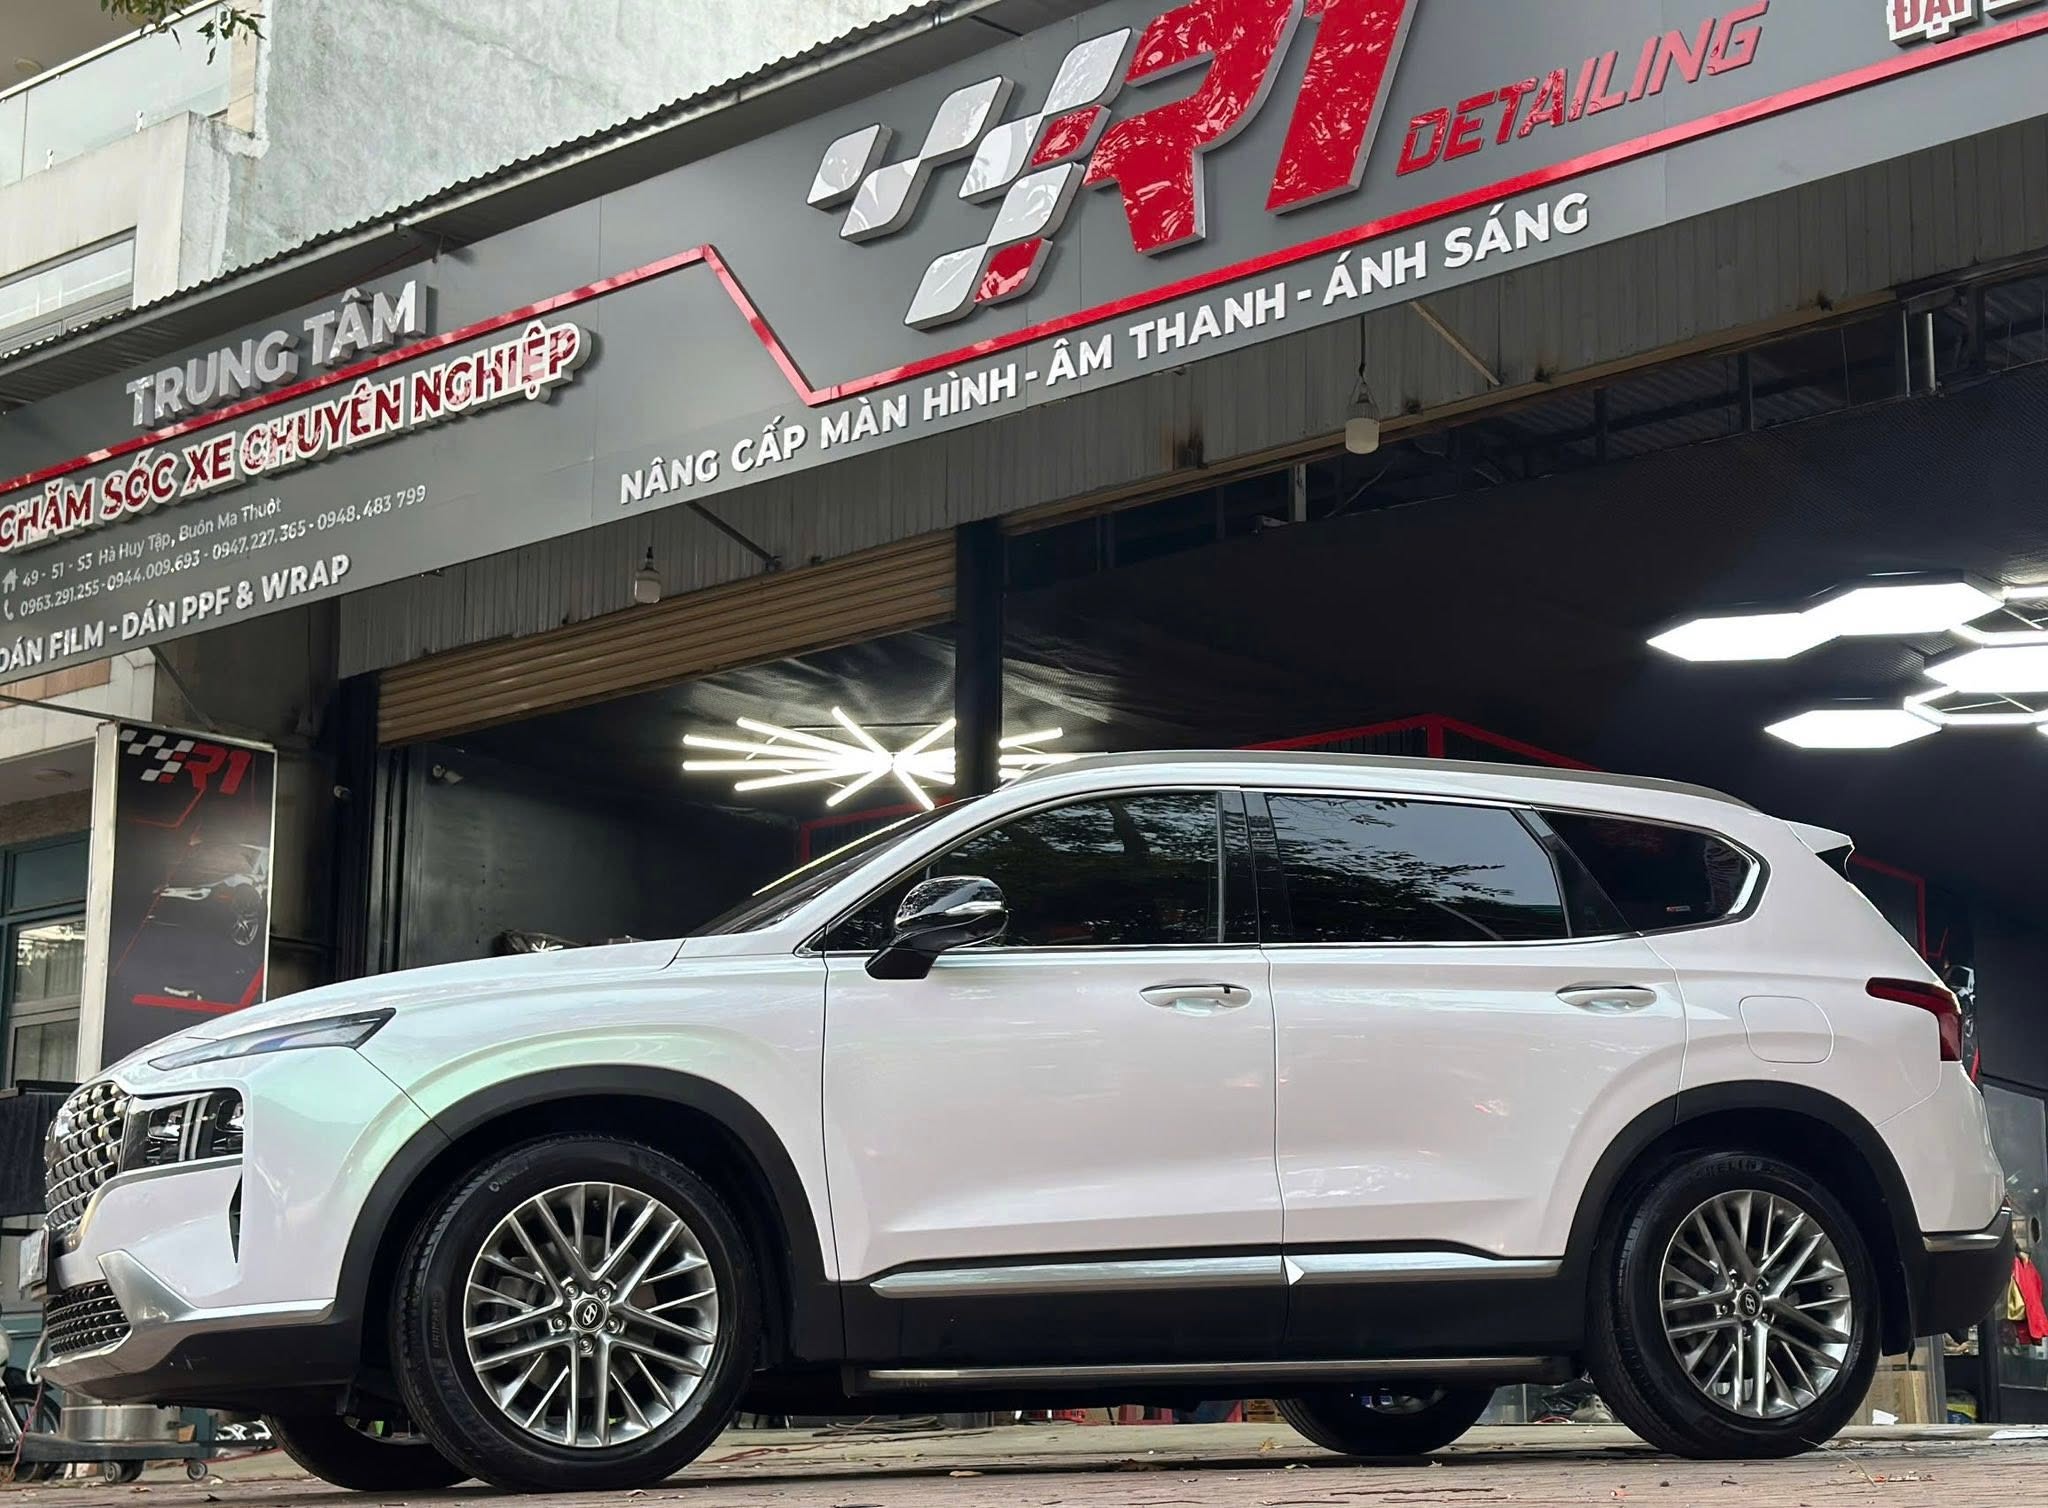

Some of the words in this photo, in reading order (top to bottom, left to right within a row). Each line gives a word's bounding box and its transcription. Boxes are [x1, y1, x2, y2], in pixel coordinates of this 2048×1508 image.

[1083, 0, 1418, 256] R1
[1396, 0, 1770, 176] DETAILING
[126, 330, 298, 427] TRUNG
[304, 280, 420, 366] TÂM
[620, 450, 718, 504] NÂNG
[731, 415, 807, 473] CẤP
[820, 397, 908, 449] MÀN
[923, 360, 1018, 421] HÌNH
[1046, 334, 1112, 386] ÂM
[1129, 282, 1286, 360] THANH
[1322, 240, 1427, 306] ÁNH
[1444, 192, 1589, 268] SÁNG
[0, 477, 96, 553] CHĂM
[100, 448, 178, 521] SÓC
[180, 431, 236, 497] XE
[240, 376, 405, 475] CHUYÊN
[411, 320, 582, 424] NGHIỆP
[22, 571, 39, 587] 49
[51, 563, 64, 579] 51
[98, 546, 115, 566] Hà
[119, 539, 145, 561] Huy
[179, 520, 214, 541] Buôn
[218, 512, 238, 531] Ma
[241, 497, 282, 523] Thuột
[50, 620, 104, 660] FILM
[122, 599, 176, 641] DÁN
[182, 585, 231, 625] PPF
[236, 581, 254, 609] &
[261, 554, 350, 603] WRAP
[183, 742, 251, 795] R1
